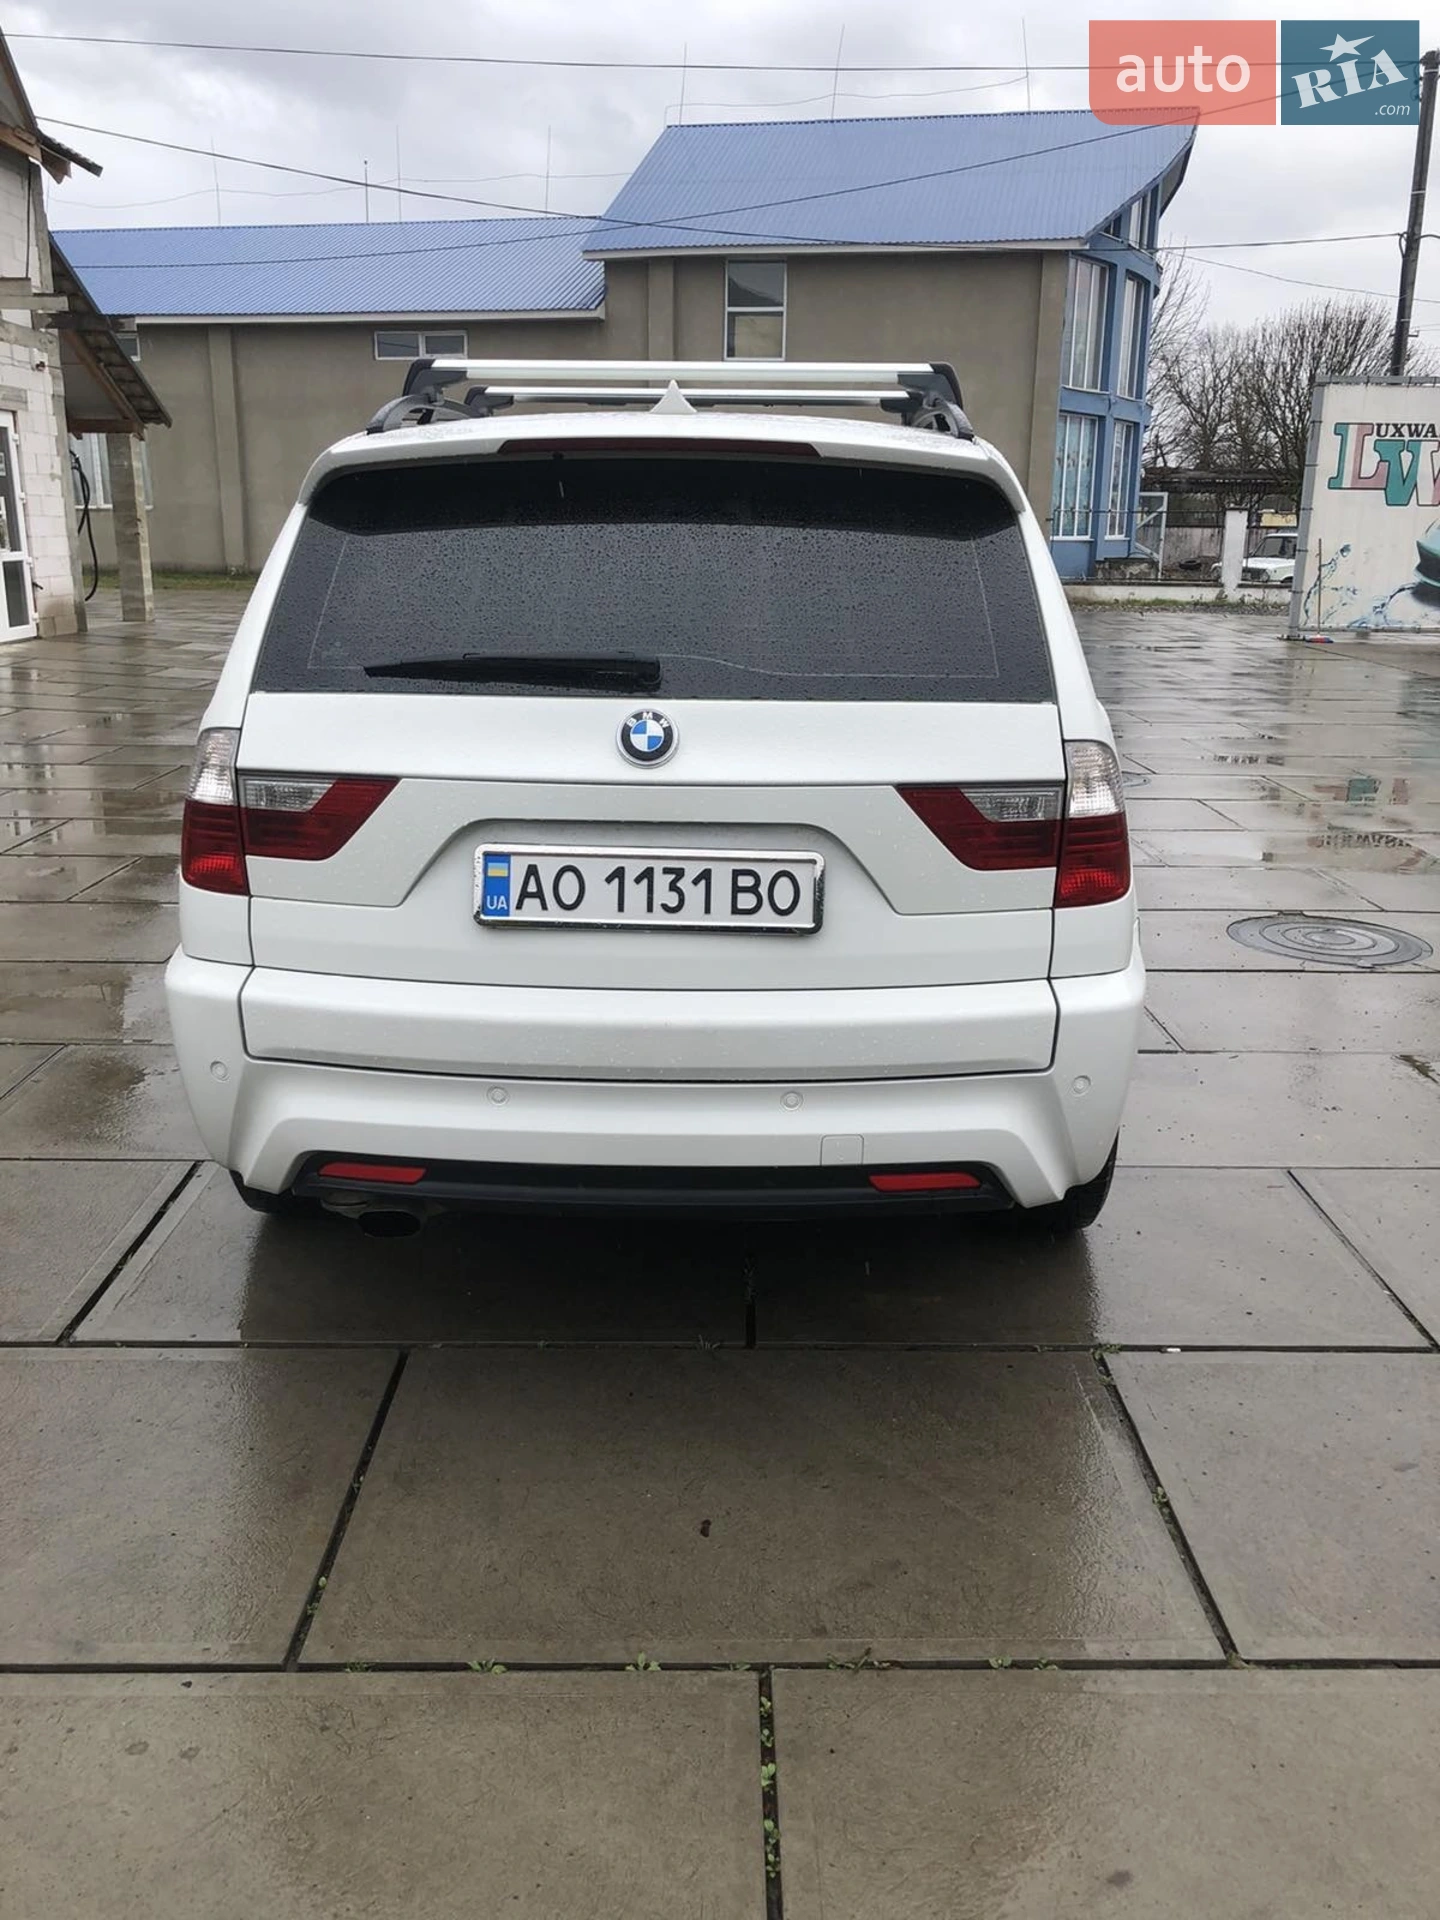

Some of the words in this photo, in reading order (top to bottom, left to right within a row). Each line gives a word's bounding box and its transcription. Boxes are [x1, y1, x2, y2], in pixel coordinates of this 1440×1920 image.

[626, 711, 670, 728] BMW
[515, 863, 586, 911] AO
[604, 866, 713, 915] 1131
[731, 868, 801, 917] BO
[486, 895, 508, 910] UA
